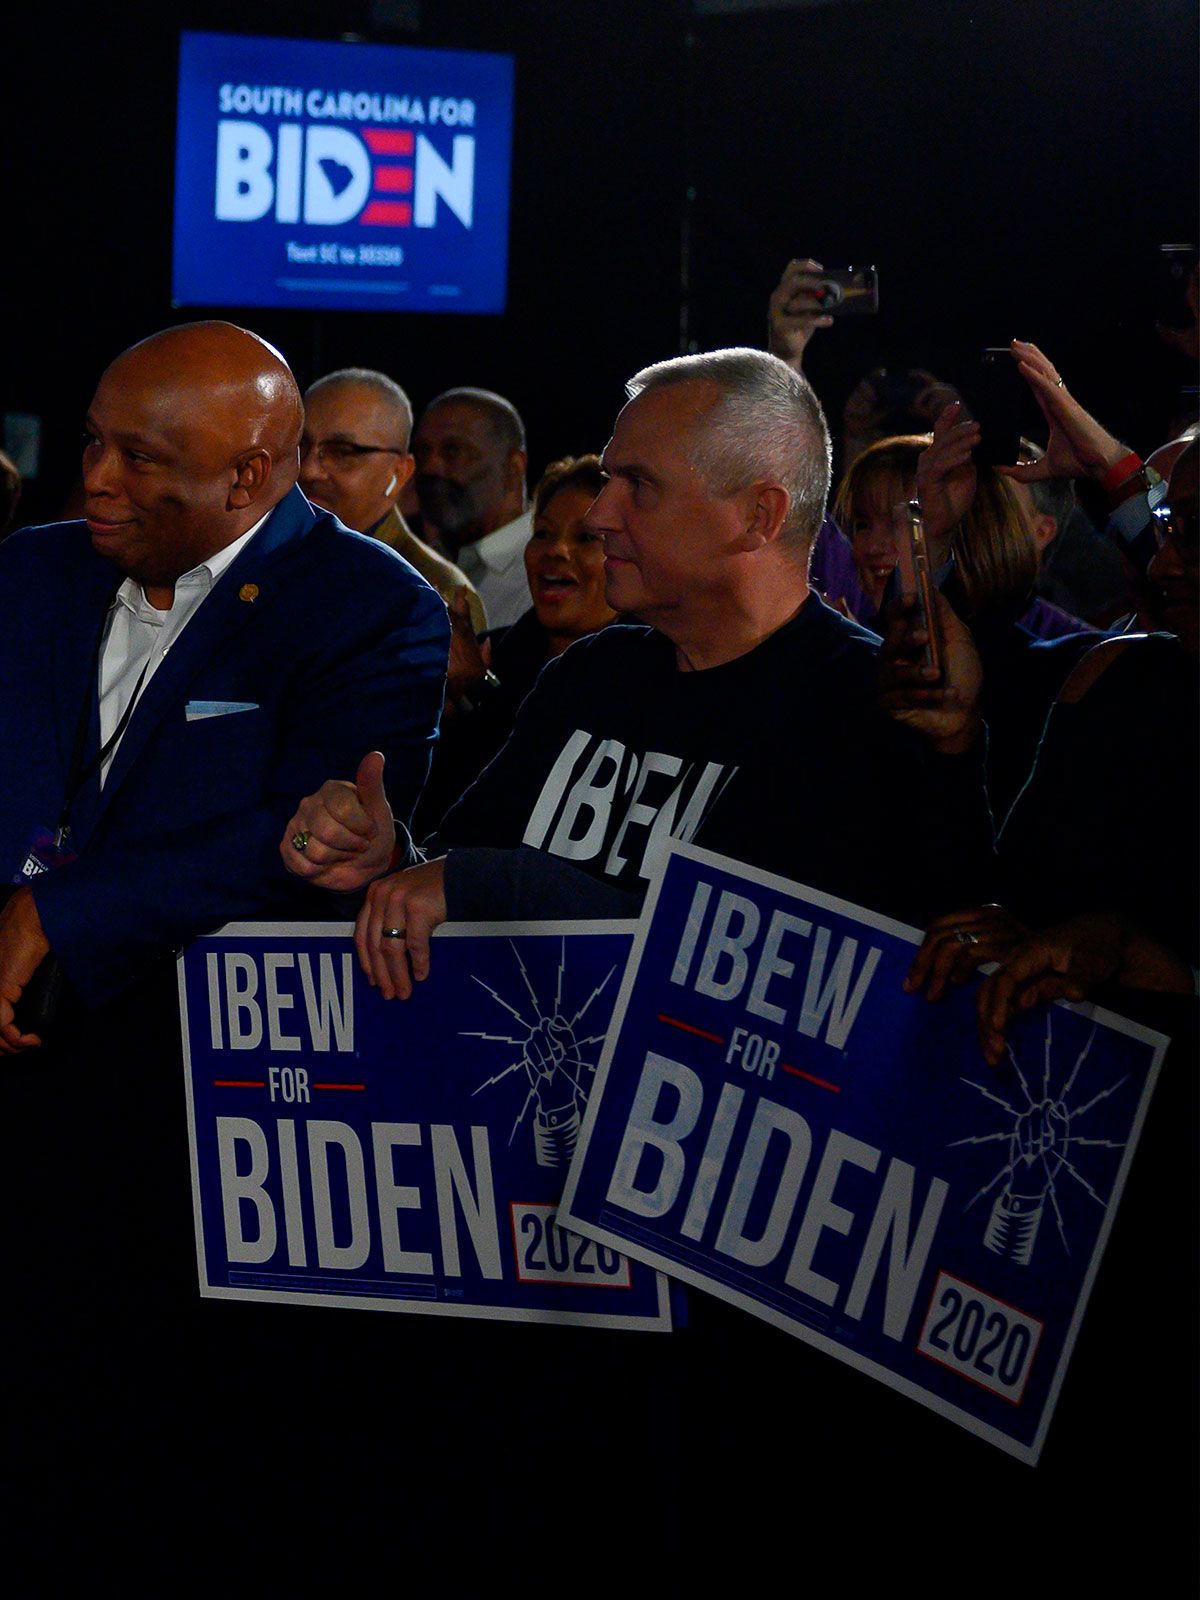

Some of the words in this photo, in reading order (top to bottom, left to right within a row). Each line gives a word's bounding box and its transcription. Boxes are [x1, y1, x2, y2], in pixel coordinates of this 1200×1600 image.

[219, 83, 303, 116] SOUTH
[306, 89, 425, 124] CAROLINA
[428, 97, 476, 127] FOR
[215, 119, 475, 230] BIDEN
[206, 952, 354, 1052] IBEW
[669, 881, 882, 1051] IBEW
[268, 1067, 310, 1103] FOR
[725, 1027, 782, 1080] FOR
[216, 1116, 503, 1280] BIDEN
[605, 1051, 950, 1342] BIDEN
[928, 1289, 1030, 1386] 2020
